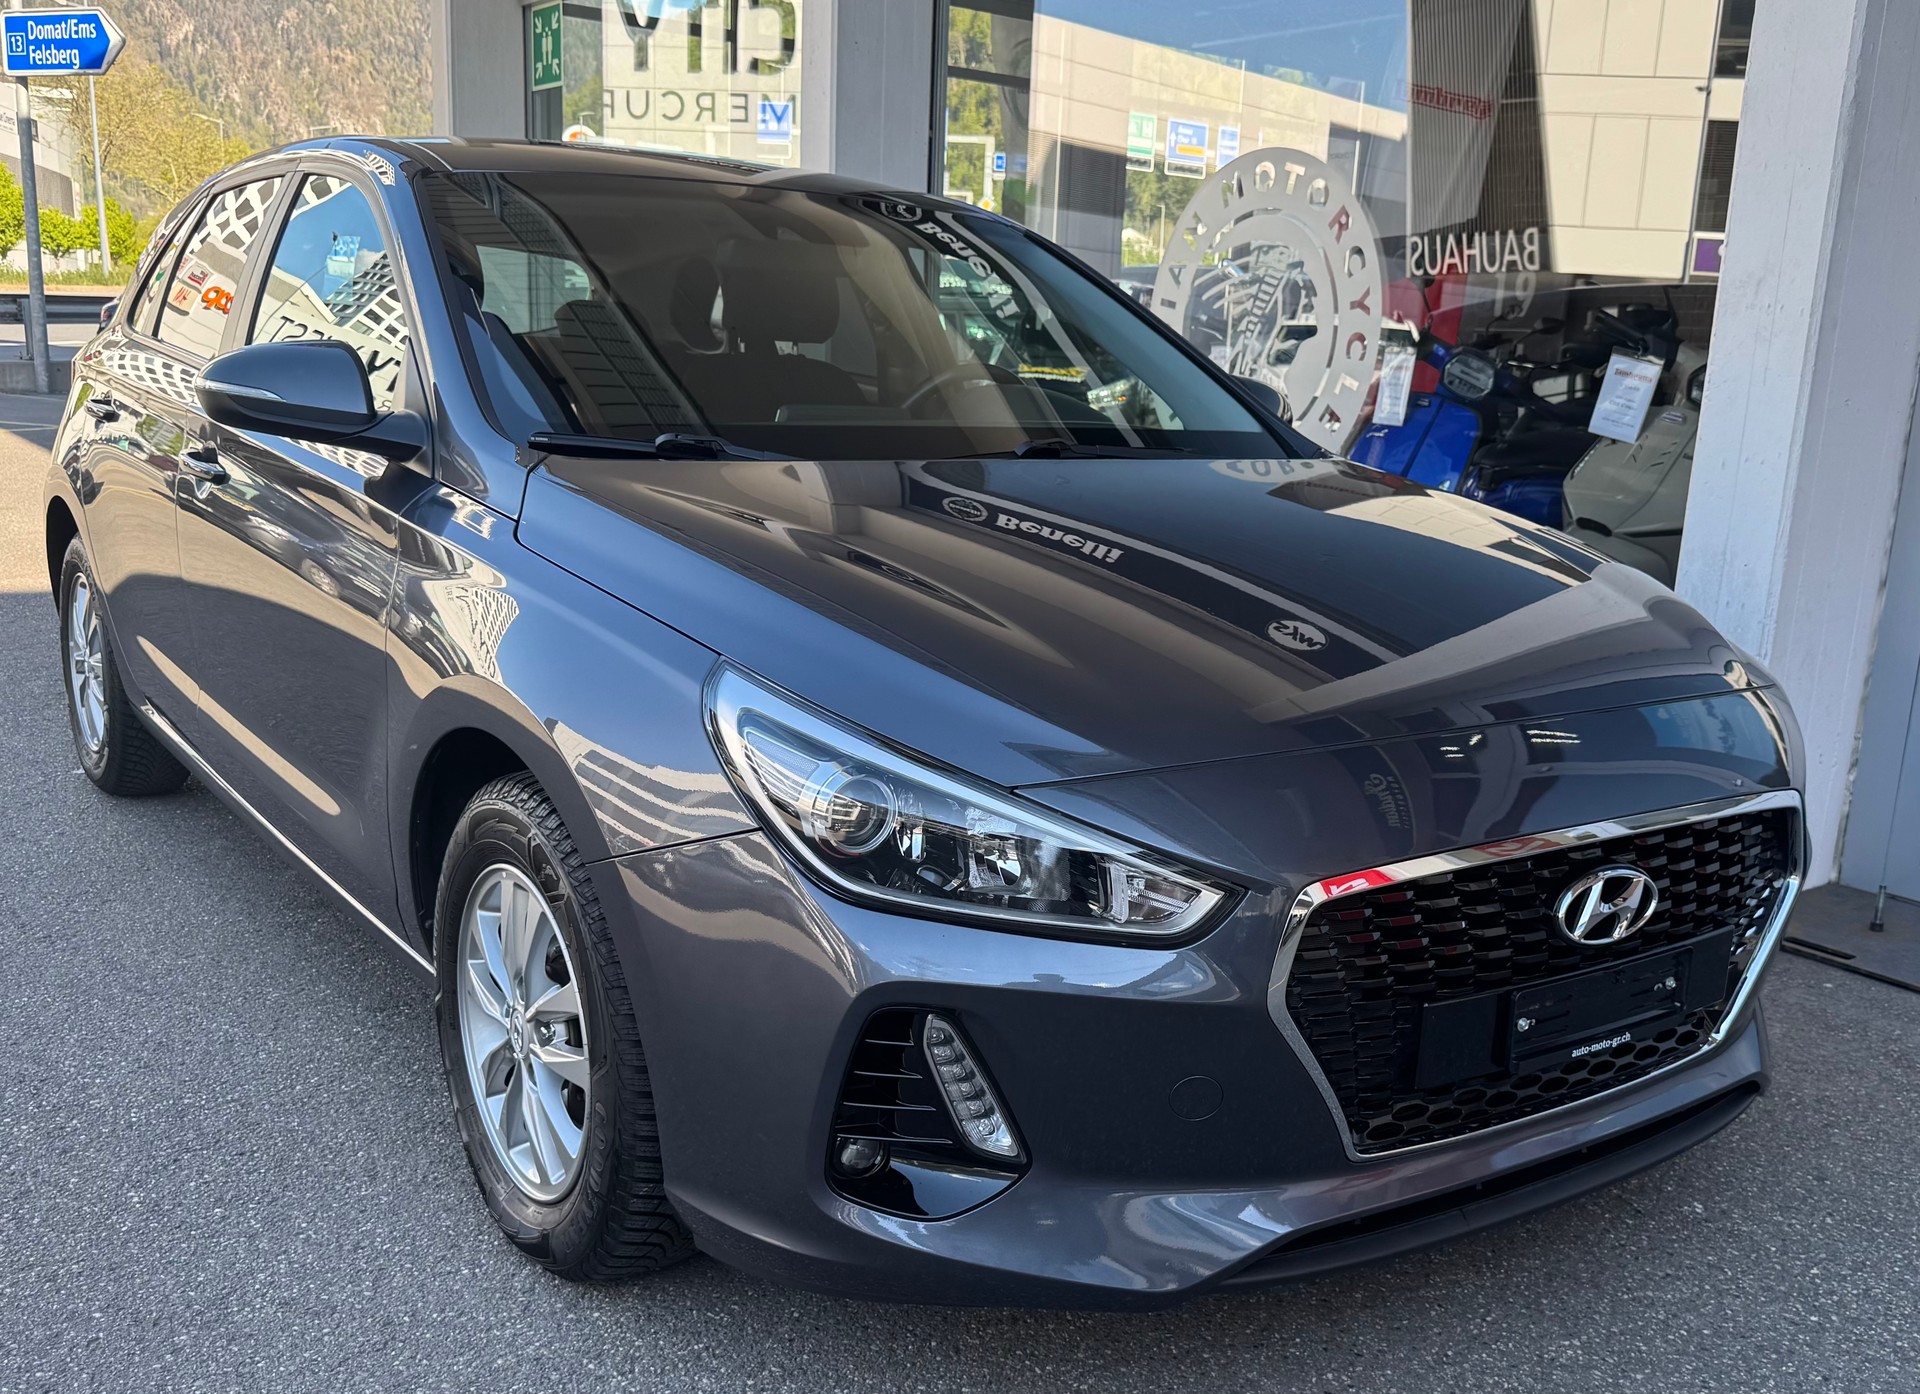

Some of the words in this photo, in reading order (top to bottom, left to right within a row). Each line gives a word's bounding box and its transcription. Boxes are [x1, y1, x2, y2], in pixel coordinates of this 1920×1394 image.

[27, 19, 97, 40] Domat/Ems
[11, 36, 22, 52] 13
[29, 44, 80, 69] Felsberg
[1222, 160, 1371, 436] MOTORCYCLE
[1572, 1031, 1631, 1057] auto-moto-gr.ch
